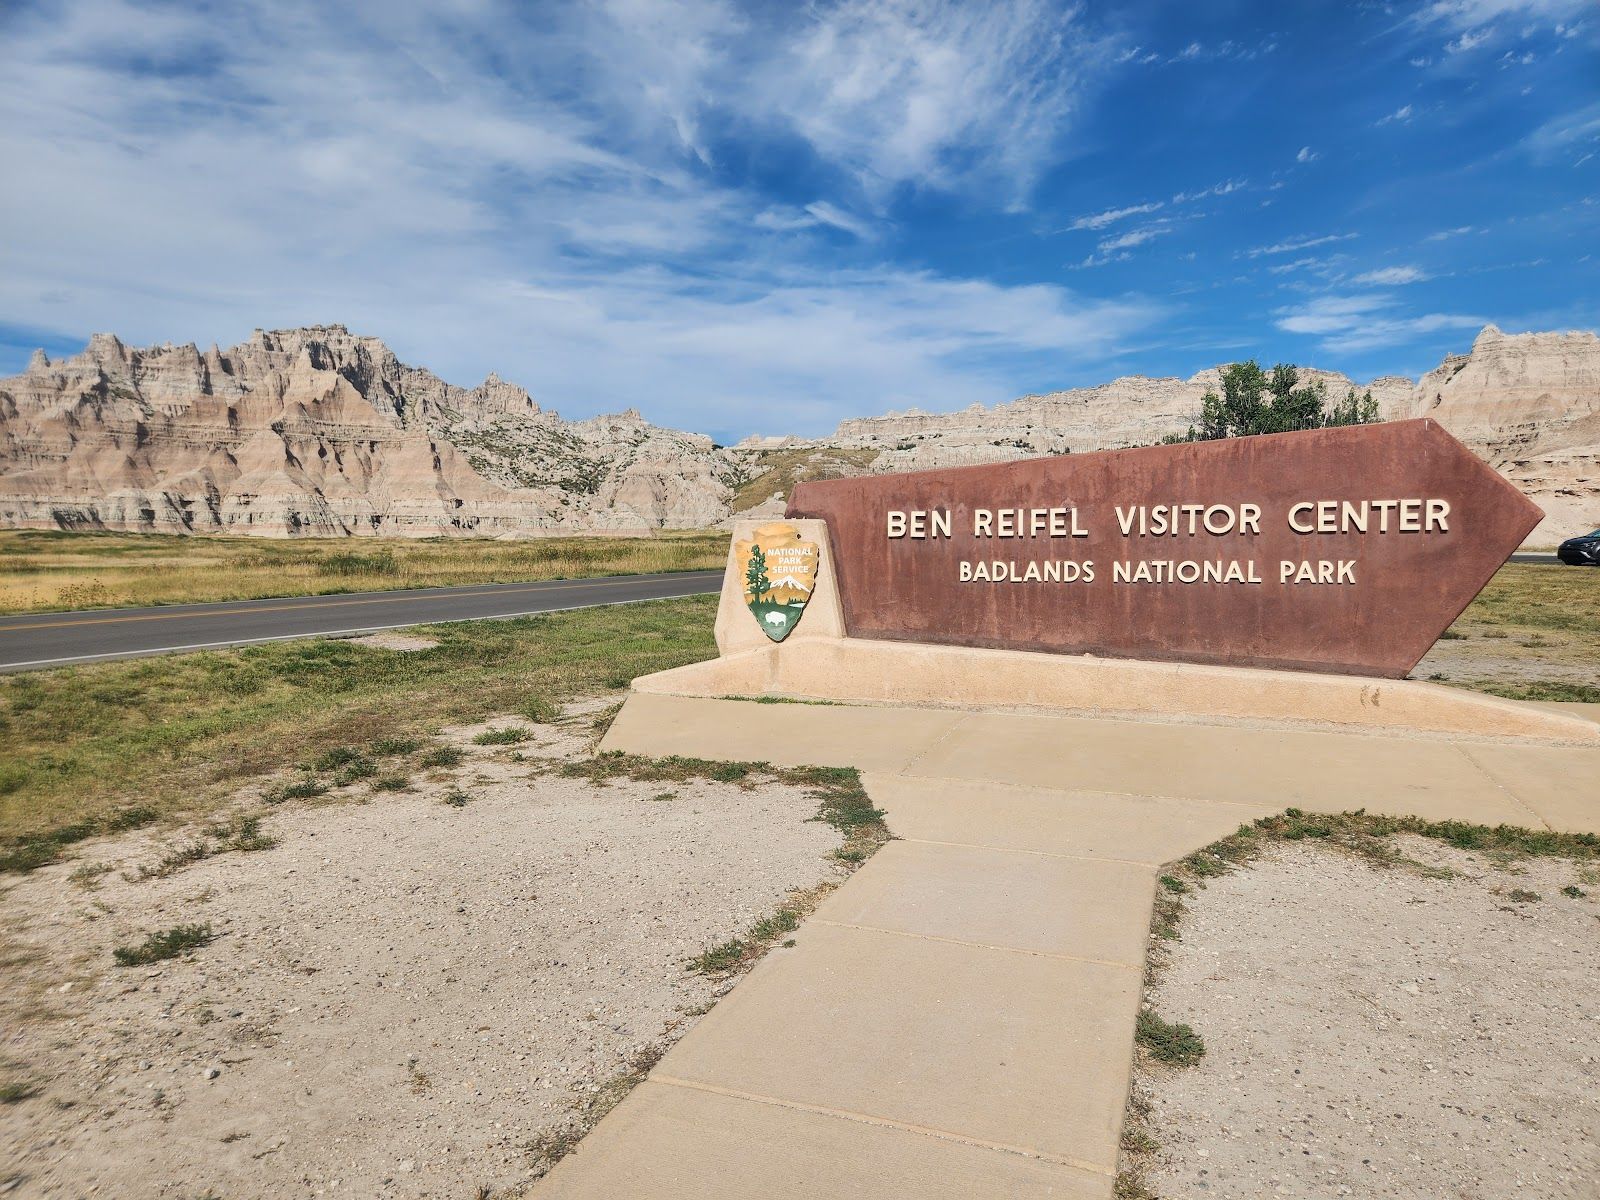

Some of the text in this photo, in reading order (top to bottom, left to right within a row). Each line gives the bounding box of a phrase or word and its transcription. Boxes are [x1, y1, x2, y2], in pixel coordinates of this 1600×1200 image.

[886, 499, 1451, 538] BEN REIFEL VISITOR CENTER
[767, 548, 813, 556] NATIONAL
[778, 556, 802, 564] PARK
[772, 565, 809, 573] SERVICE
[959, 560, 1357, 584] BADLANDS NATIONAL PARK
